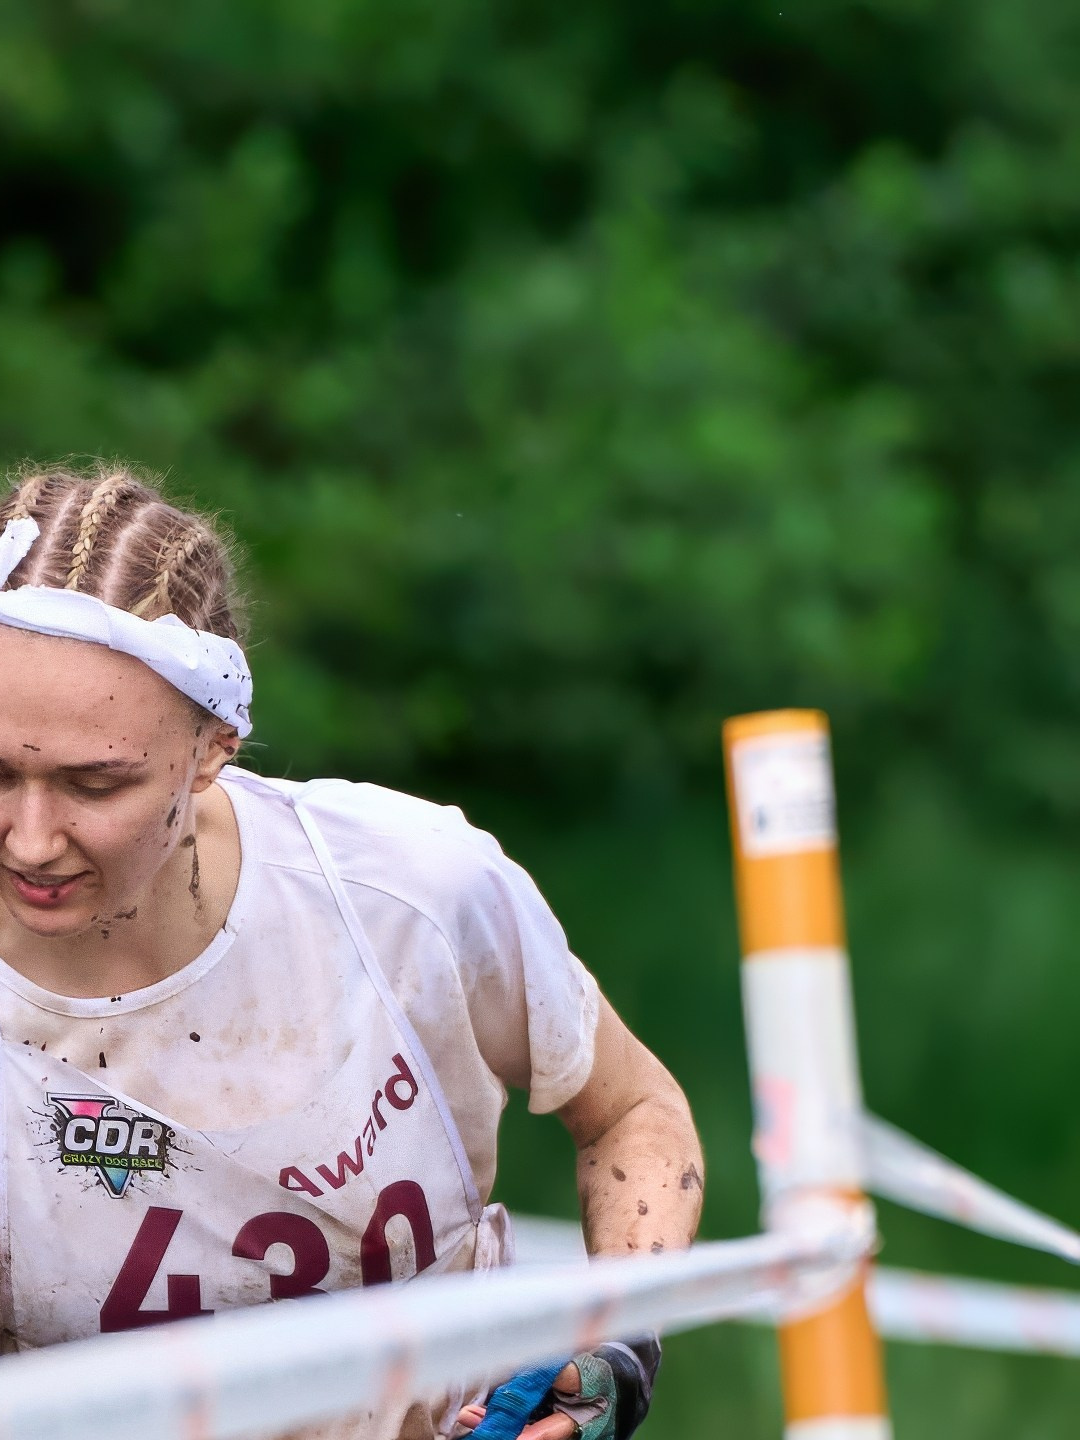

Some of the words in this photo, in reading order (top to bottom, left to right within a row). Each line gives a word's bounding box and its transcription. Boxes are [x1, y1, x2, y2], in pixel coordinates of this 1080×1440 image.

[63, 1154, 101, 1164] CRAZY
[105, 1156, 128, 1167] DOG
[65, 1118, 162, 1155] CDR
[278, 1052, 419, 1198] Award
[99, 1179, 437, 1334] 430
